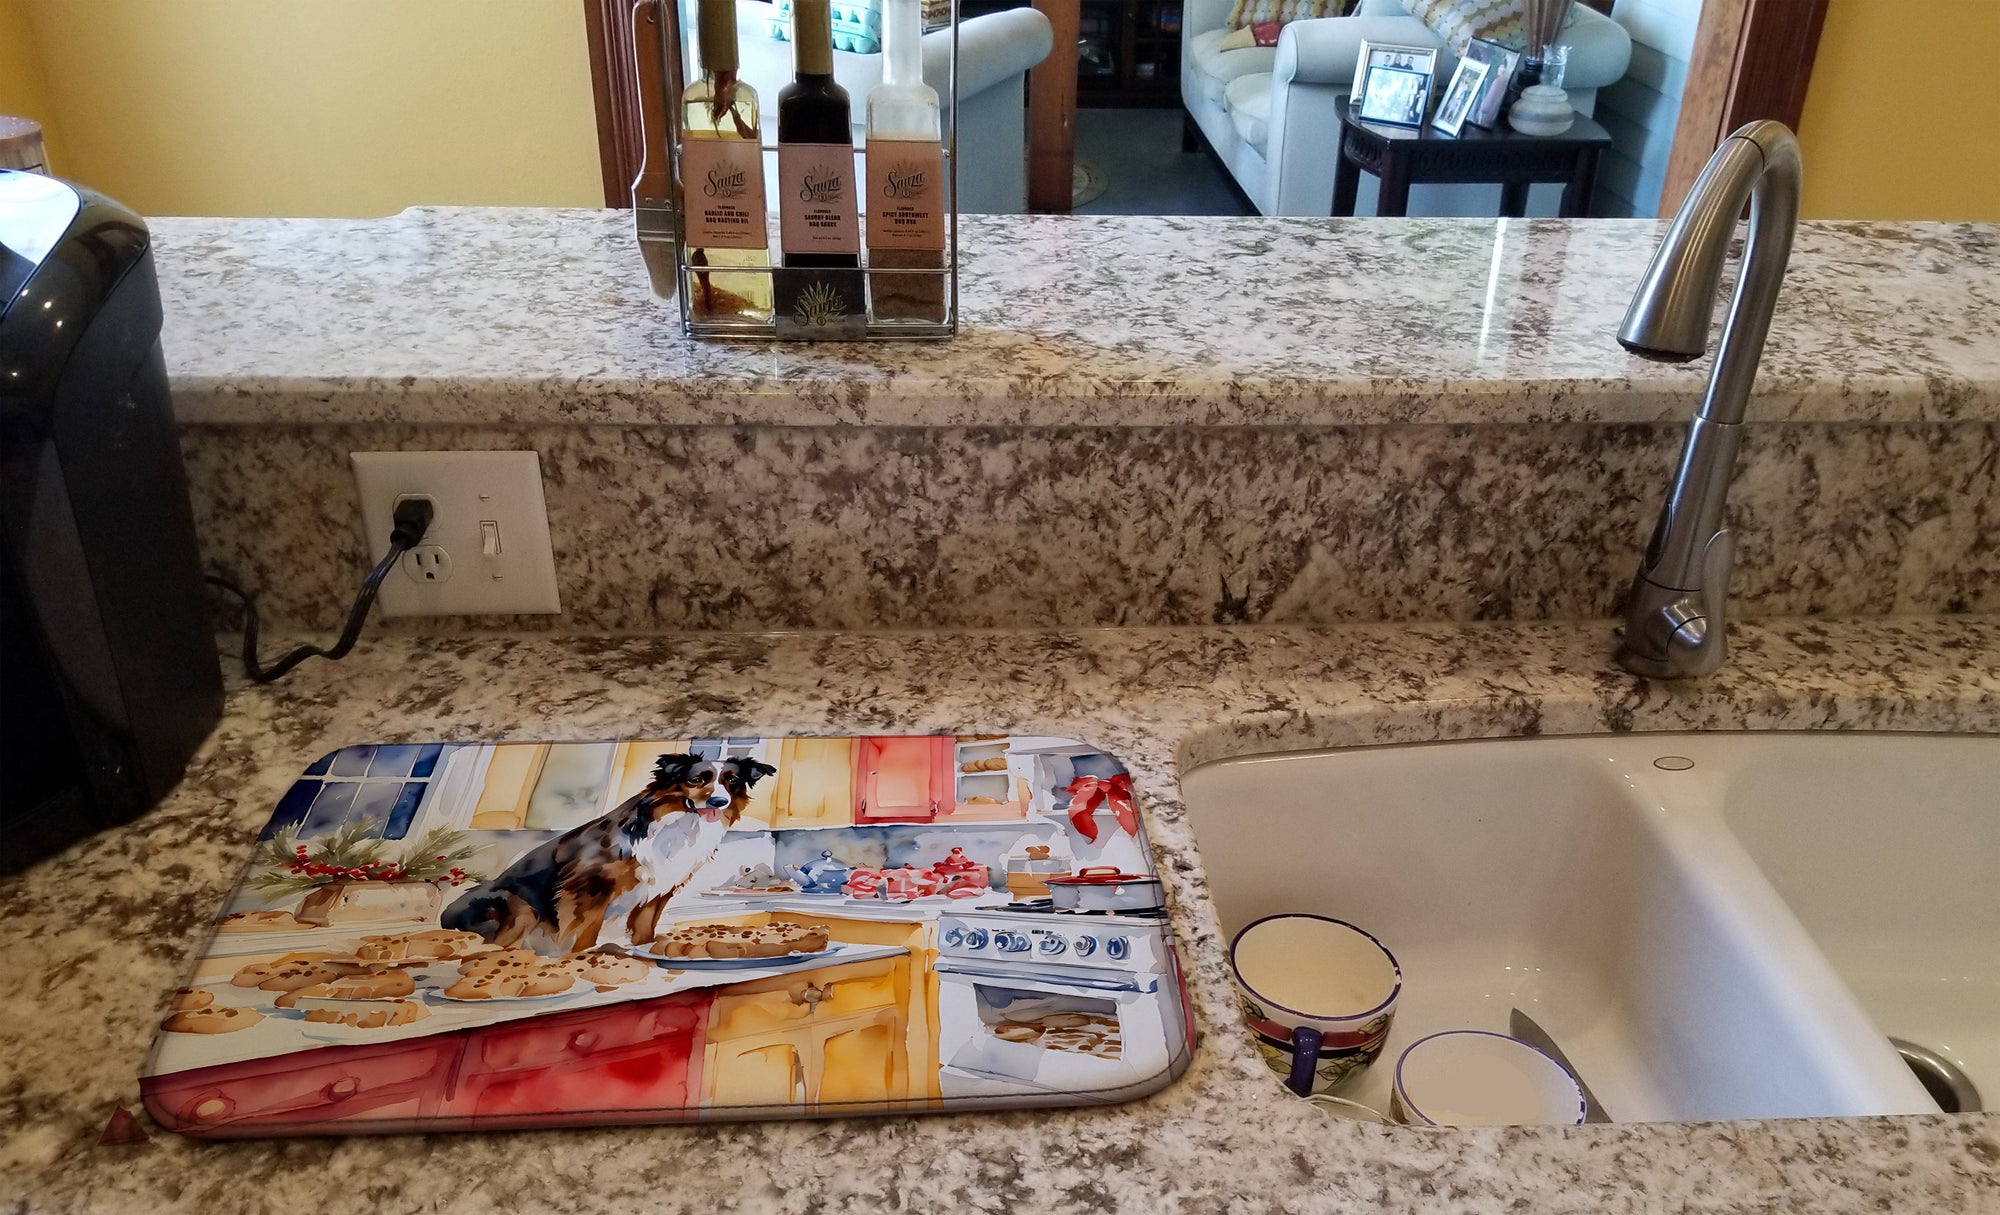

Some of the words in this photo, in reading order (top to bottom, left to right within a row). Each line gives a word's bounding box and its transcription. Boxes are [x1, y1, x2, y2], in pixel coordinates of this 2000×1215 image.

[703, 170, 745, 197] Sauza
[800, 175, 841, 202] Sauza
[883, 171, 926, 198] Sauza
[793, 295, 844, 326] Sauza
